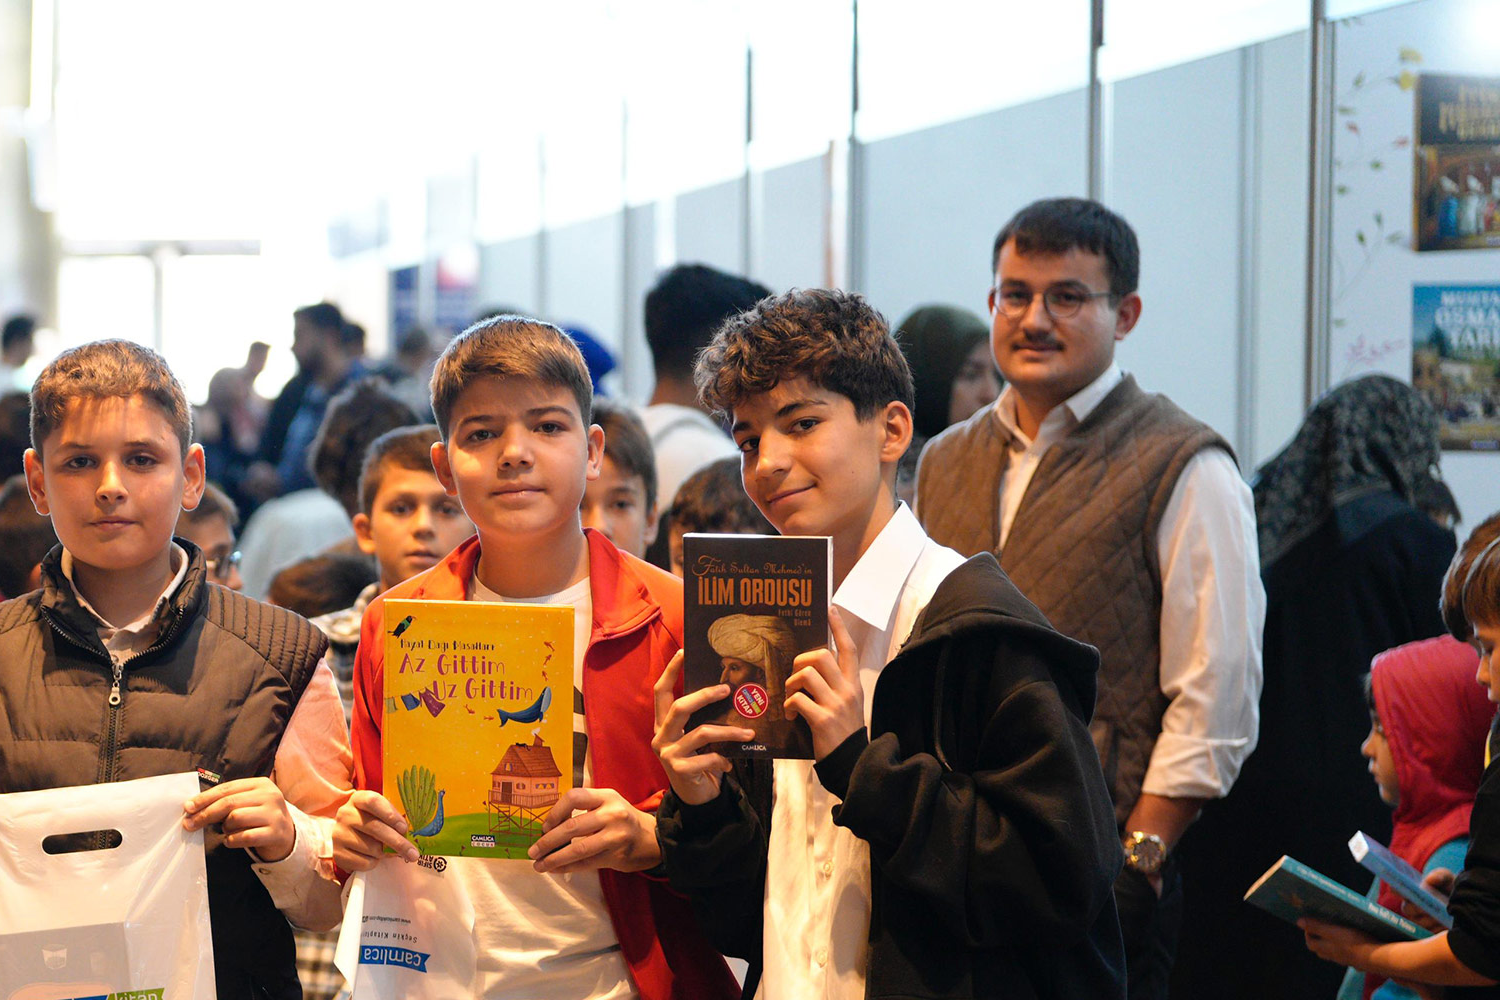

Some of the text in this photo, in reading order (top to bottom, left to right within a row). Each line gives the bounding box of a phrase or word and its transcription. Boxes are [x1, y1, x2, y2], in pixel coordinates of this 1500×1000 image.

[730, 562, 759, 574] Sultan
[698, 576, 812, 607] İLİM ORDUSU
[399, 653, 505, 675] Az Gittim
[432, 677, 533, 701] Uz Gittim
[392, 932, 418, 944] Seçkin
